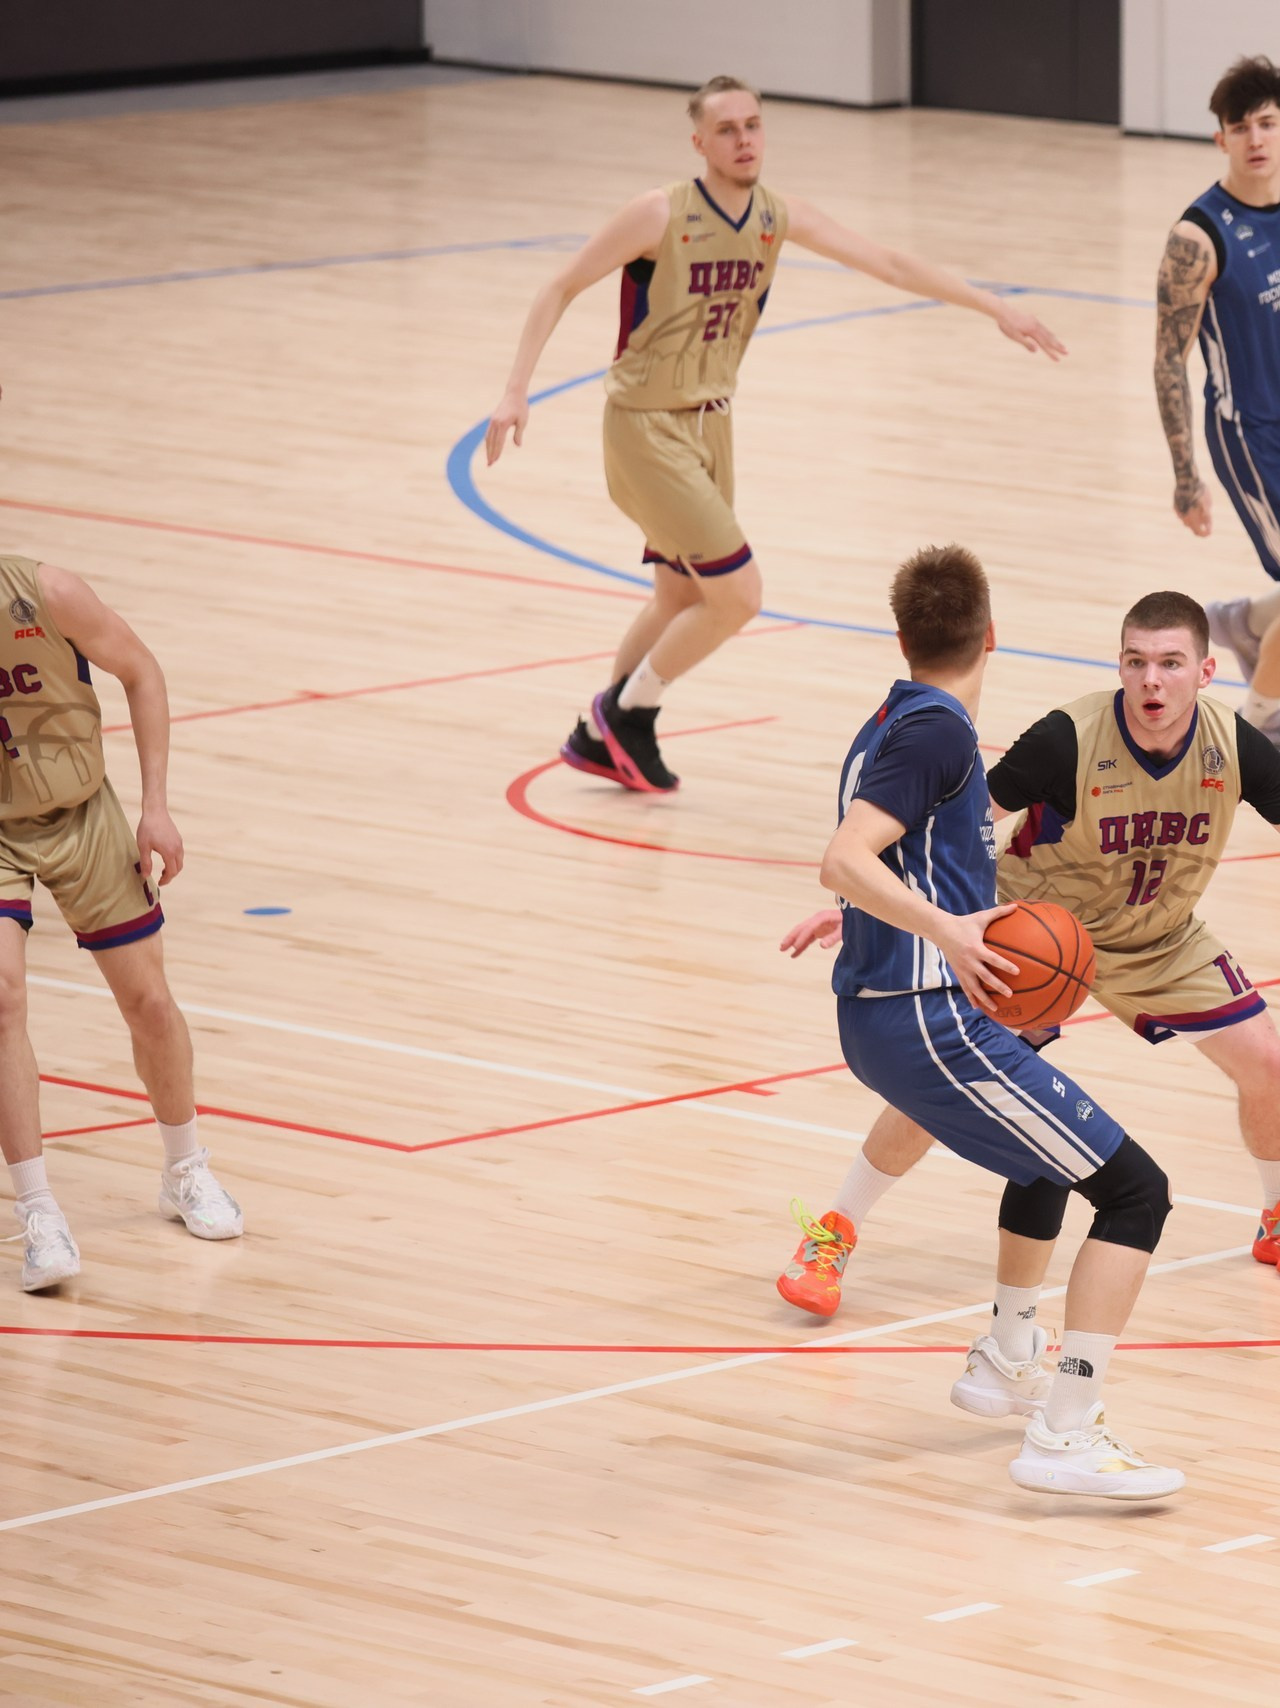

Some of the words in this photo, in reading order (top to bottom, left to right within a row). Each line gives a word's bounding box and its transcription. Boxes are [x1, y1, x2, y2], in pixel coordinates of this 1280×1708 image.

[702, 301, 740, 341] 27
[1099, 811, 1210, 855] ЦИВС
[1125, 859, 1168, 906] 12
[1059, 1367, 1078, 1376] FACE
[1064, 1356, 1079, 1365] THE
